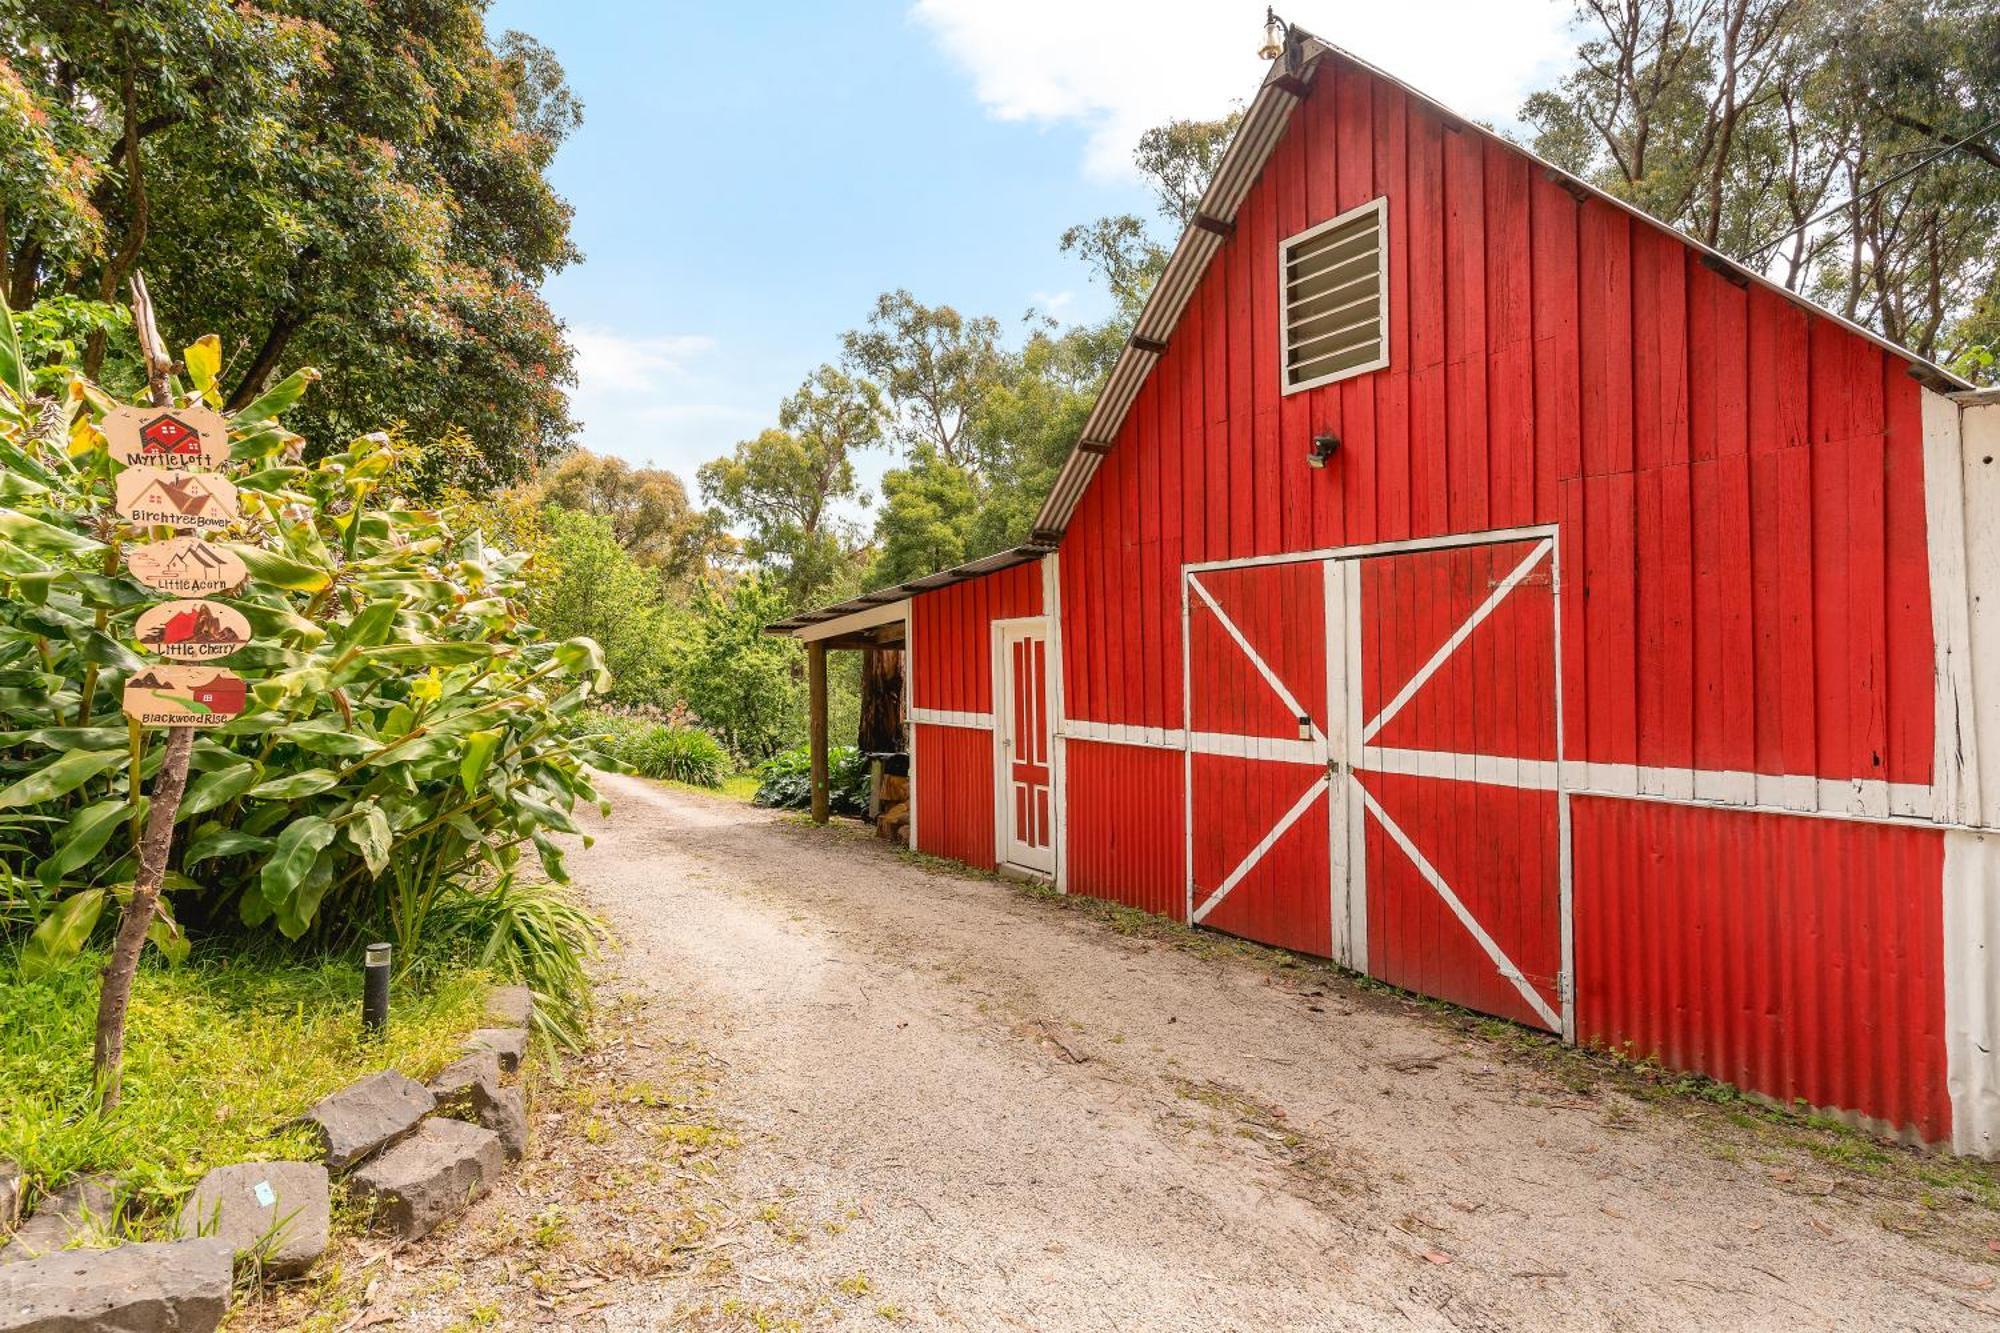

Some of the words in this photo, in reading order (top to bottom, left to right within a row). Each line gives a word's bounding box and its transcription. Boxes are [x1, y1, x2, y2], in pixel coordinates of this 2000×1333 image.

[127, 453, 178, 466] Myrtle
[180, 454, 212, 466] Loft
[197, 516, 231, 528] Bower
[158, 579, 191, 590] Little
[191, 579, 226, 590] Acorn
[157, 643, 194, 656] Little
[199, 643, 236, 656] Cherry
[142, 713, 203, 723] Blackwood
[204, 713, 228, 723] Rise
